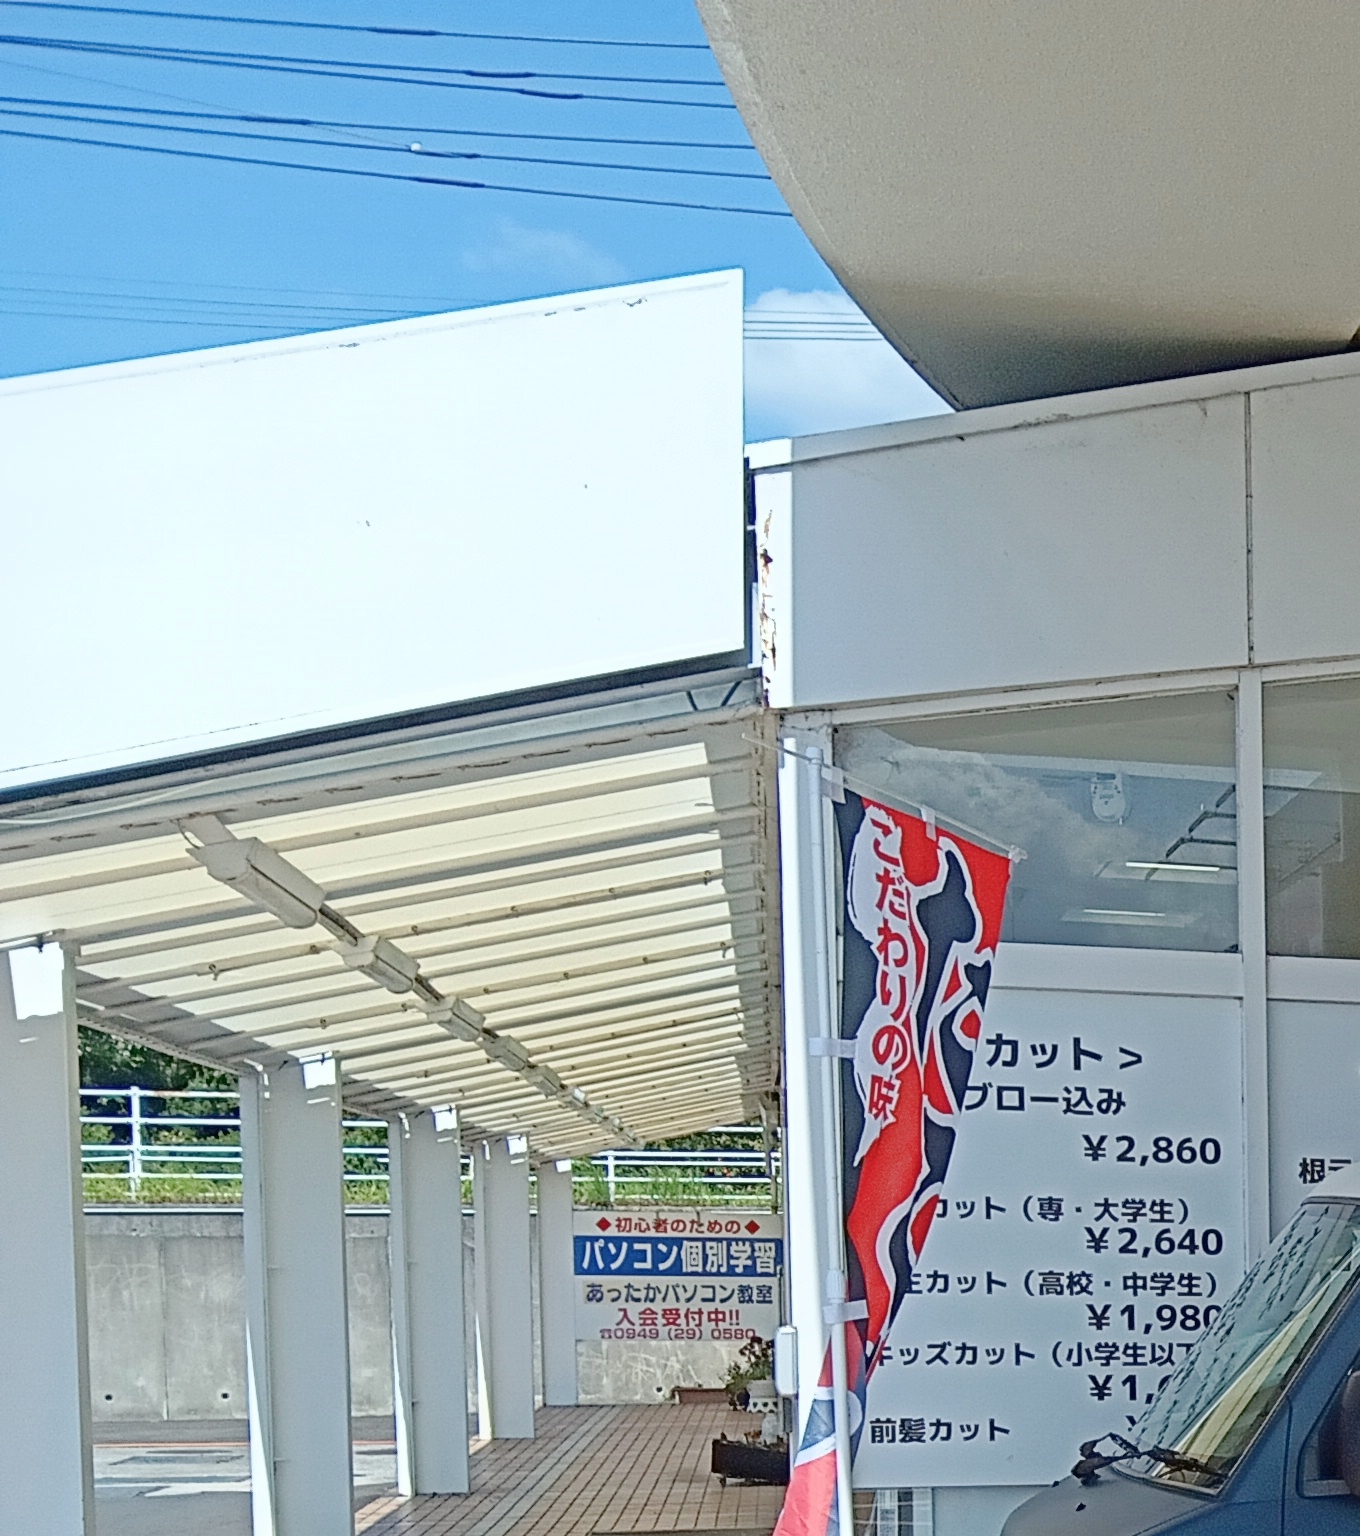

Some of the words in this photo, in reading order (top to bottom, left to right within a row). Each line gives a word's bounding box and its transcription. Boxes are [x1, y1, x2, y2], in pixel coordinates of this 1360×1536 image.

[869, 816, 910, 1121] こだわりの味
[962, 1083, 1126, 1116] ブロー込み
[1082, 1134, 1222, 1166] ¥2,860
[615, 1217, 740, 1234] 初心者のための
[582, 1238, 776, 1274] パソコン個別学習
[1084, 1227, 1224, 1258] ¥2,640
[586, 1282, 773, 1304] あったかパソコン教室
[616, 1308, 740, 1327] 入会受付中!!
[1088, 1374, 1173, 1404] ¥1,
[870, 1418, 1010, 1444] 前髪カット
